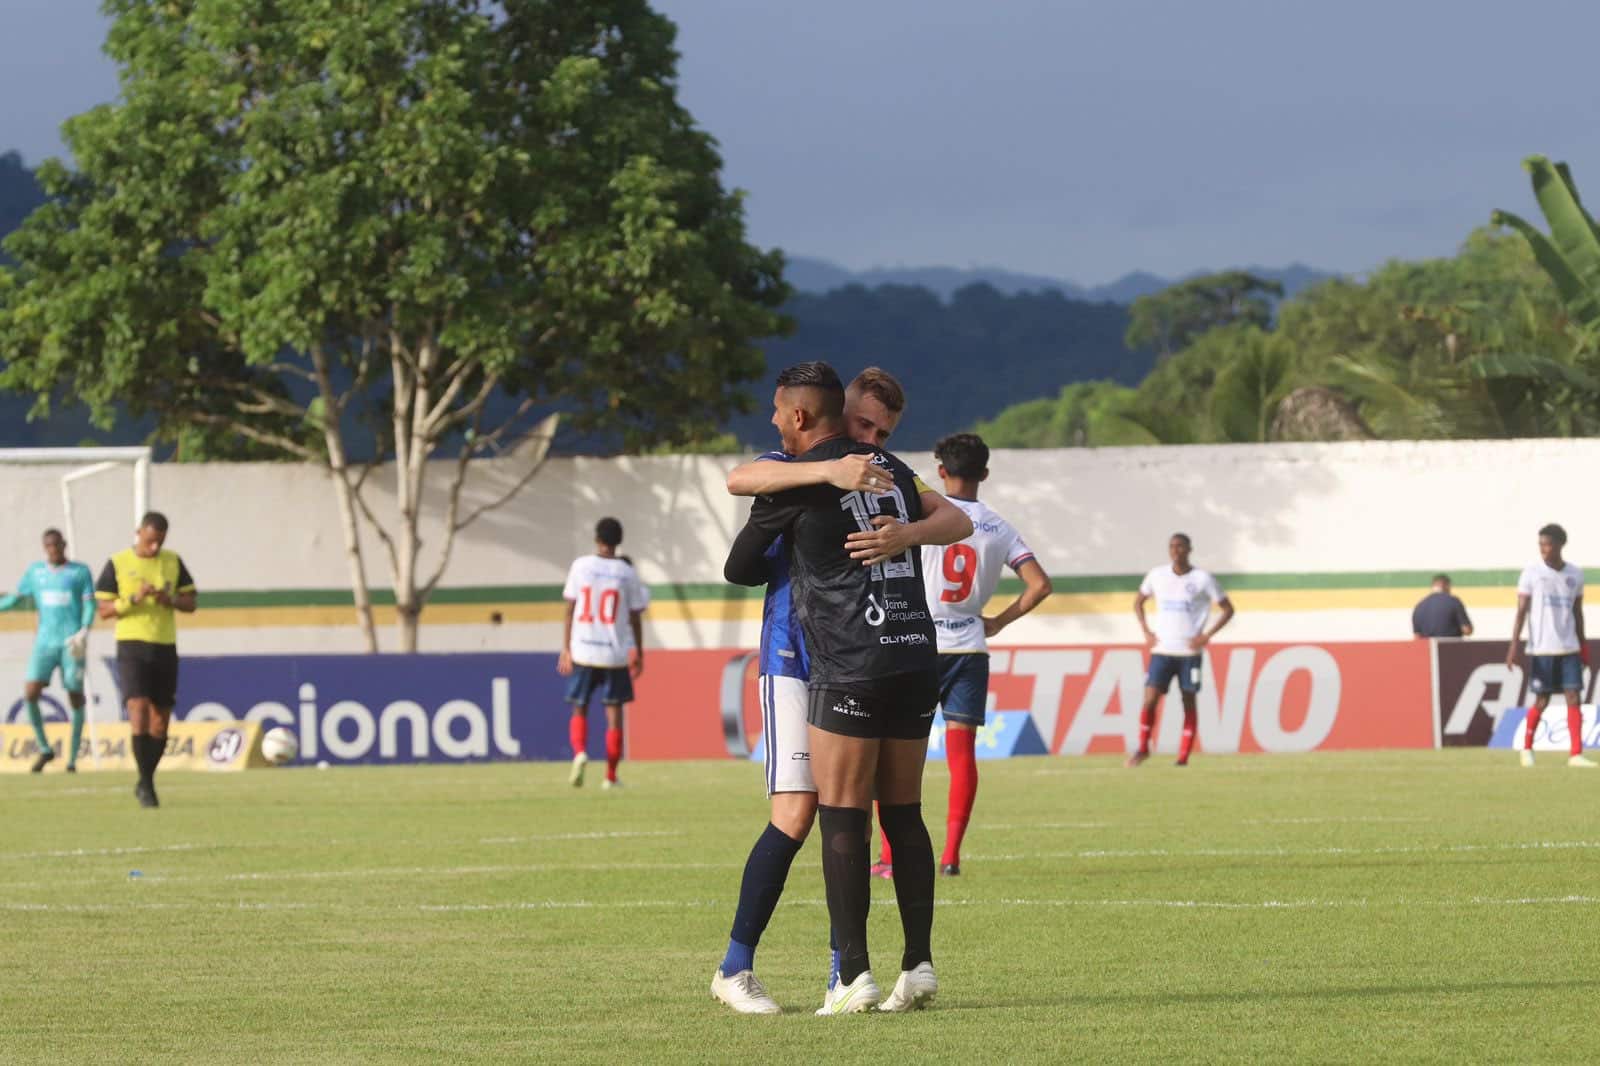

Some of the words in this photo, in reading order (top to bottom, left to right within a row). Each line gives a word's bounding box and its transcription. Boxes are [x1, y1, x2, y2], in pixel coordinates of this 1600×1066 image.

[940, 543, 977, 603] 9
[577, 585, 621, 625] 10
[880, 633, 929, 645] OLYMPIA
